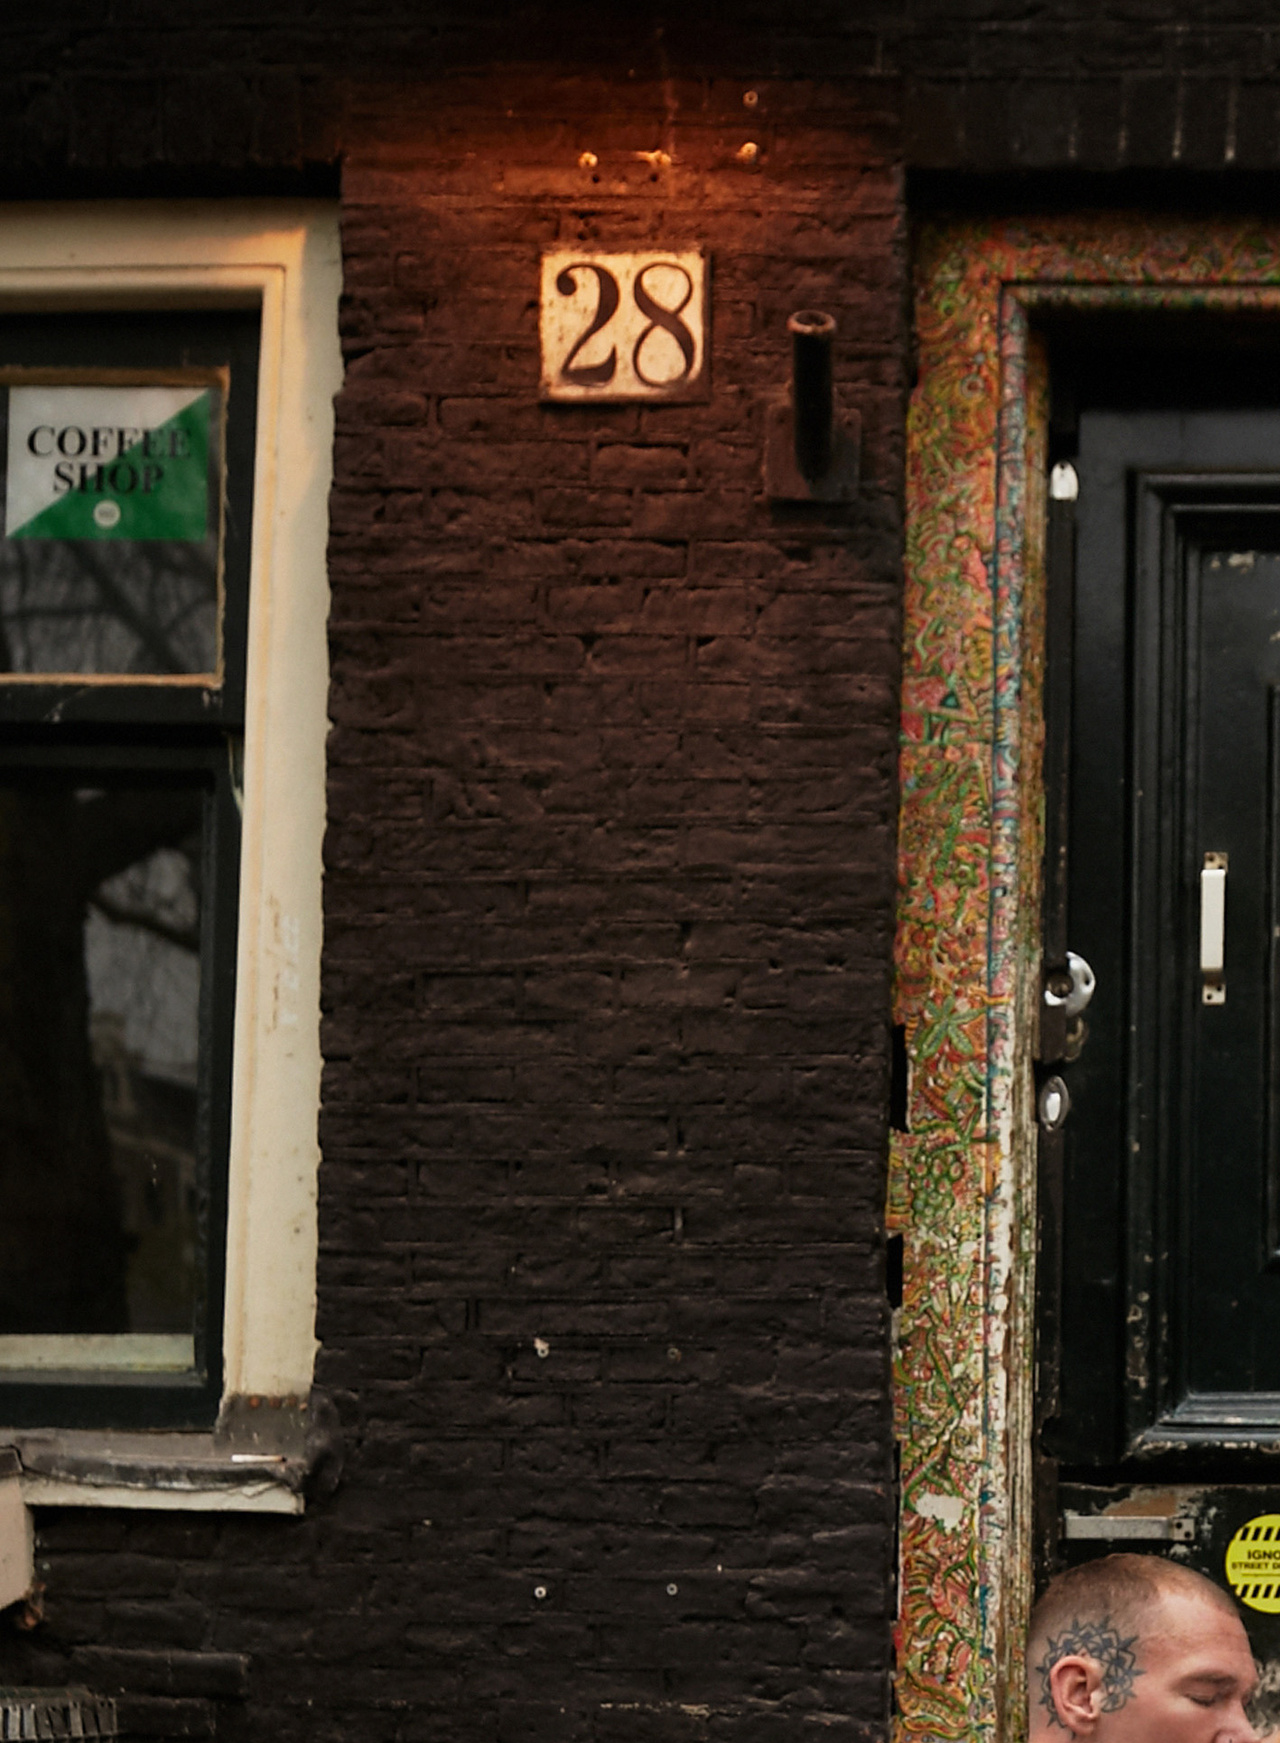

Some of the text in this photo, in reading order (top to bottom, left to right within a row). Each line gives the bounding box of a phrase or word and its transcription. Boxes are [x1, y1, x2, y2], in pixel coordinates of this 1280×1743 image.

[556, 261, 695, 388] 28
[27, 425, 191, 458] COFFEE
[53, 461, 164, 496] SHOP
[1231, 1561, 1269, 1570] STREET
